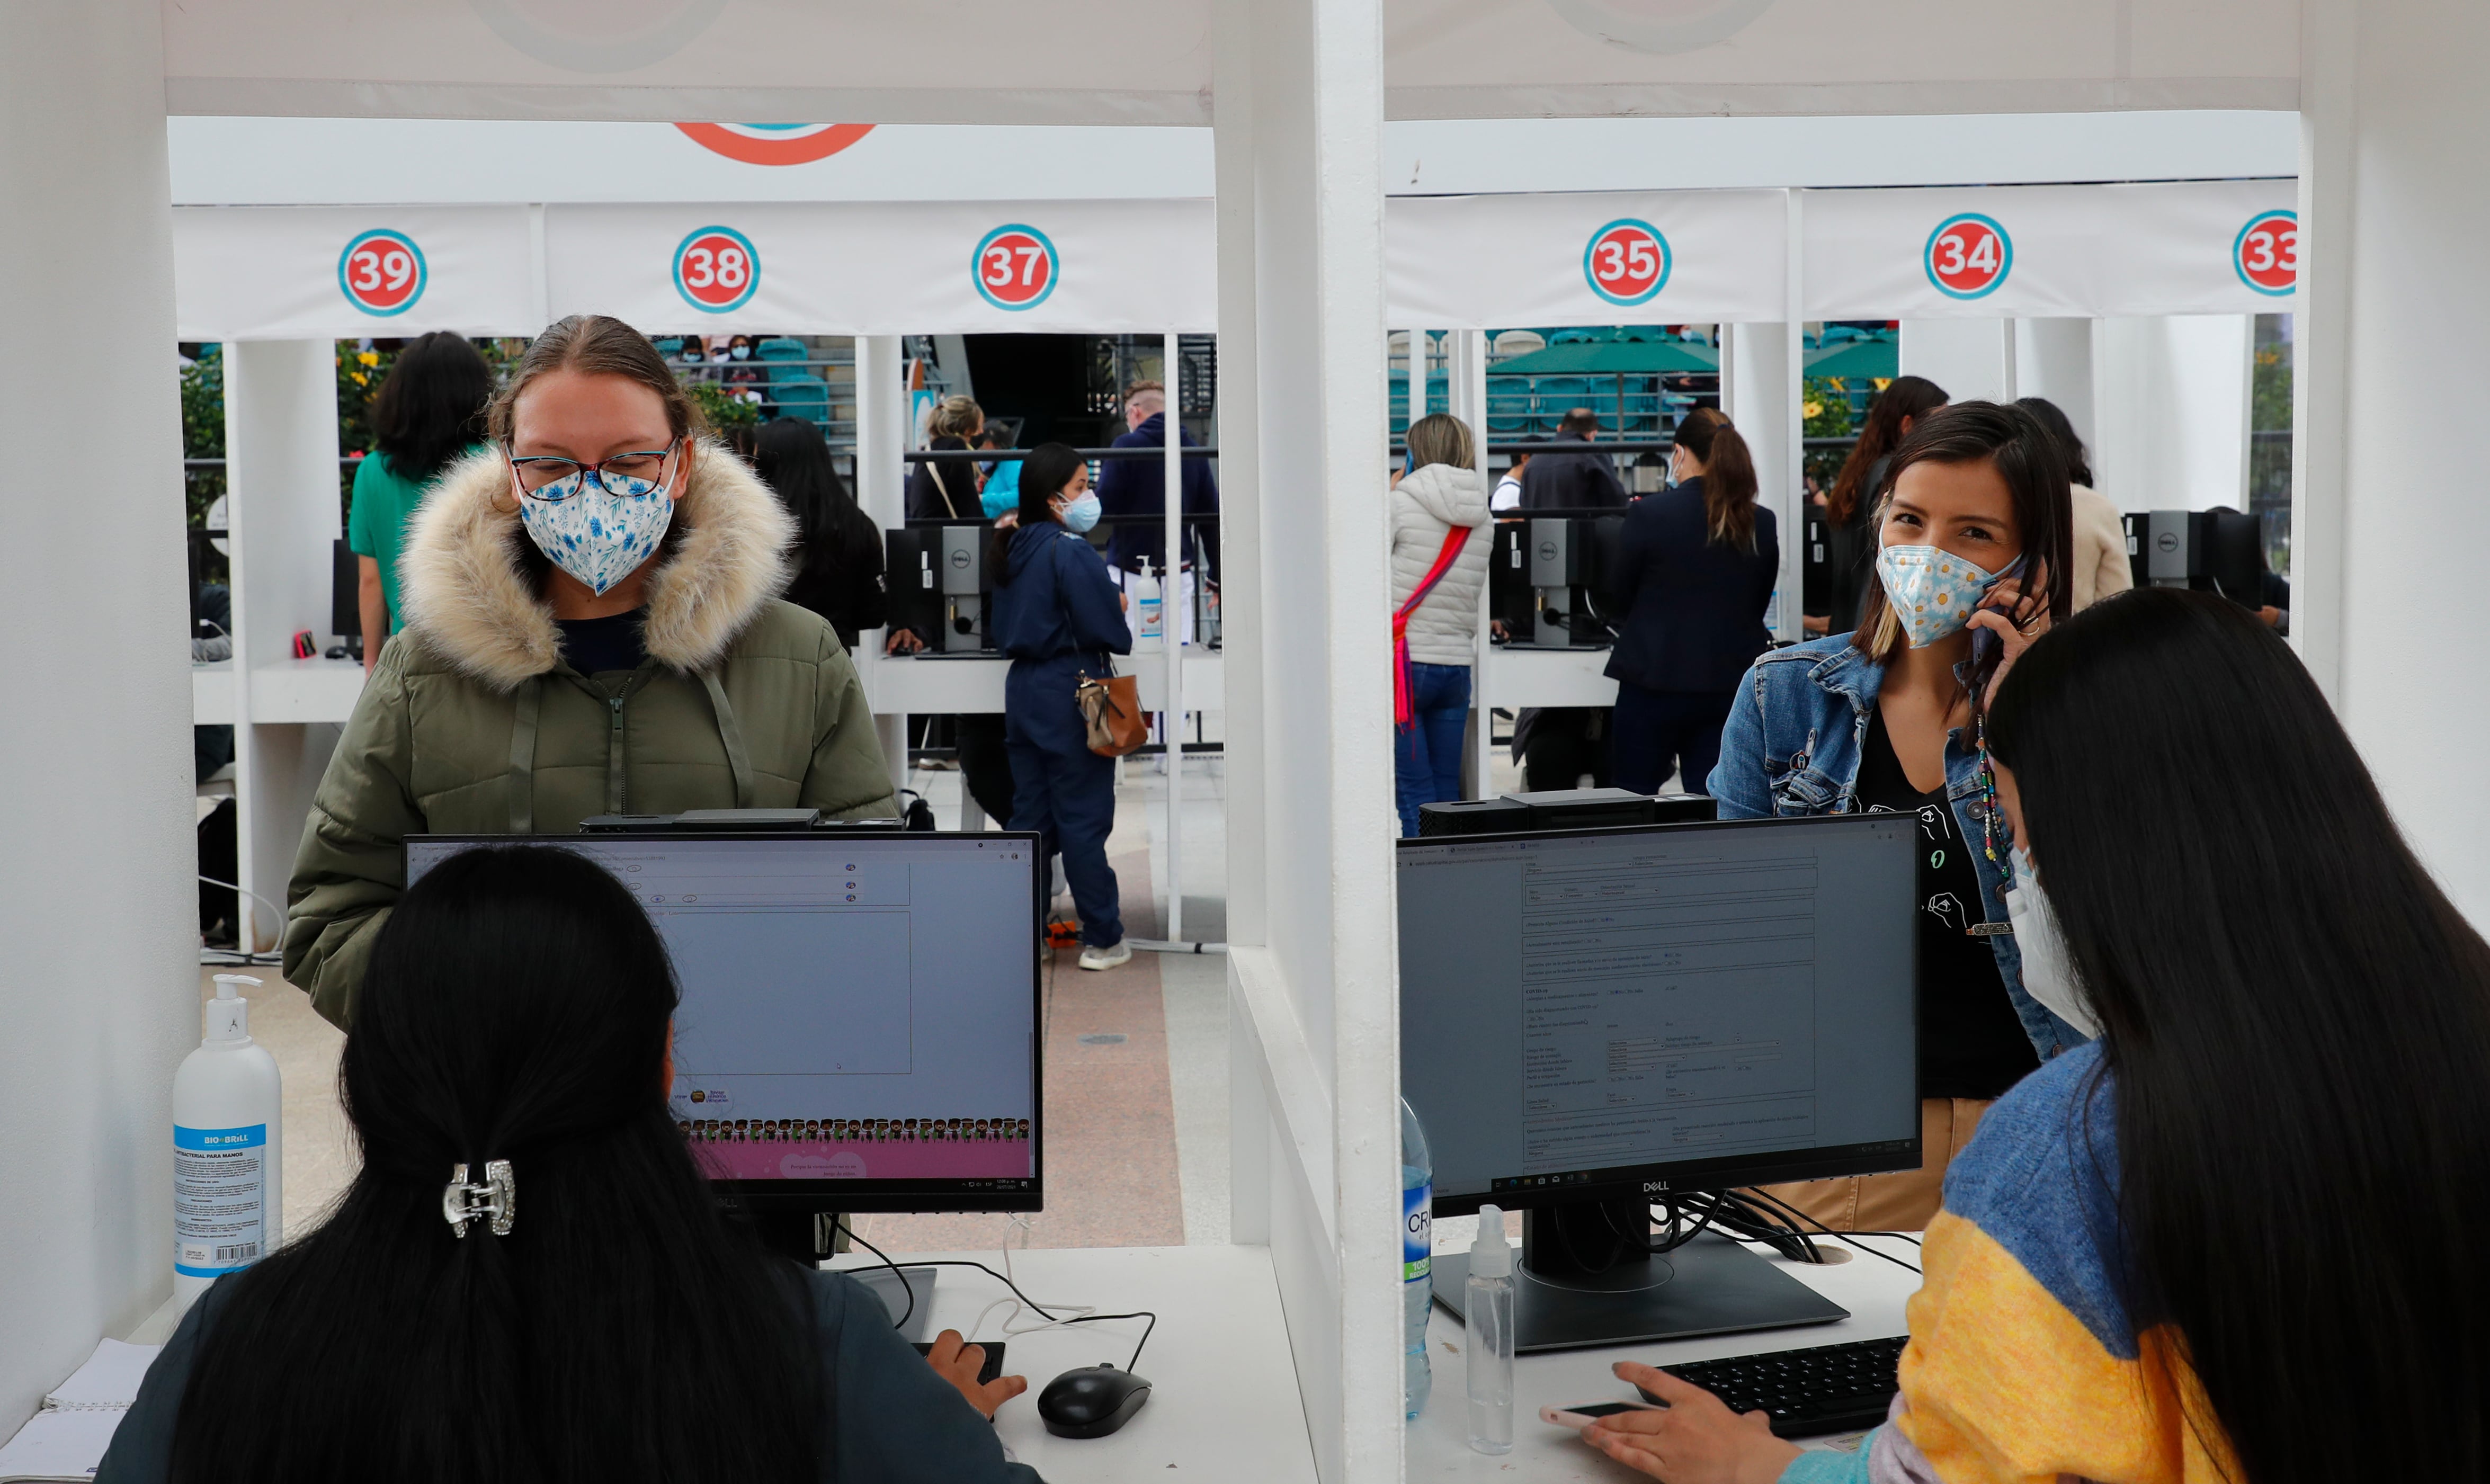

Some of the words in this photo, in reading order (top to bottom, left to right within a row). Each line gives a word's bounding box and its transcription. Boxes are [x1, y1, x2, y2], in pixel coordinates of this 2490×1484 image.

[353, 251, 411, 291] 39
[688, 248, 745, 288] 38
[986, 246, 1042, 287] 37
[1598, 240, 1656, 281] 35
[1939, 234, 1997, 274] 34
[2247, 231, 2297, 271] 33
[1643, 1181, 1670, 1192] DELL
[1408, 1208, 1431, 1233] CRI
